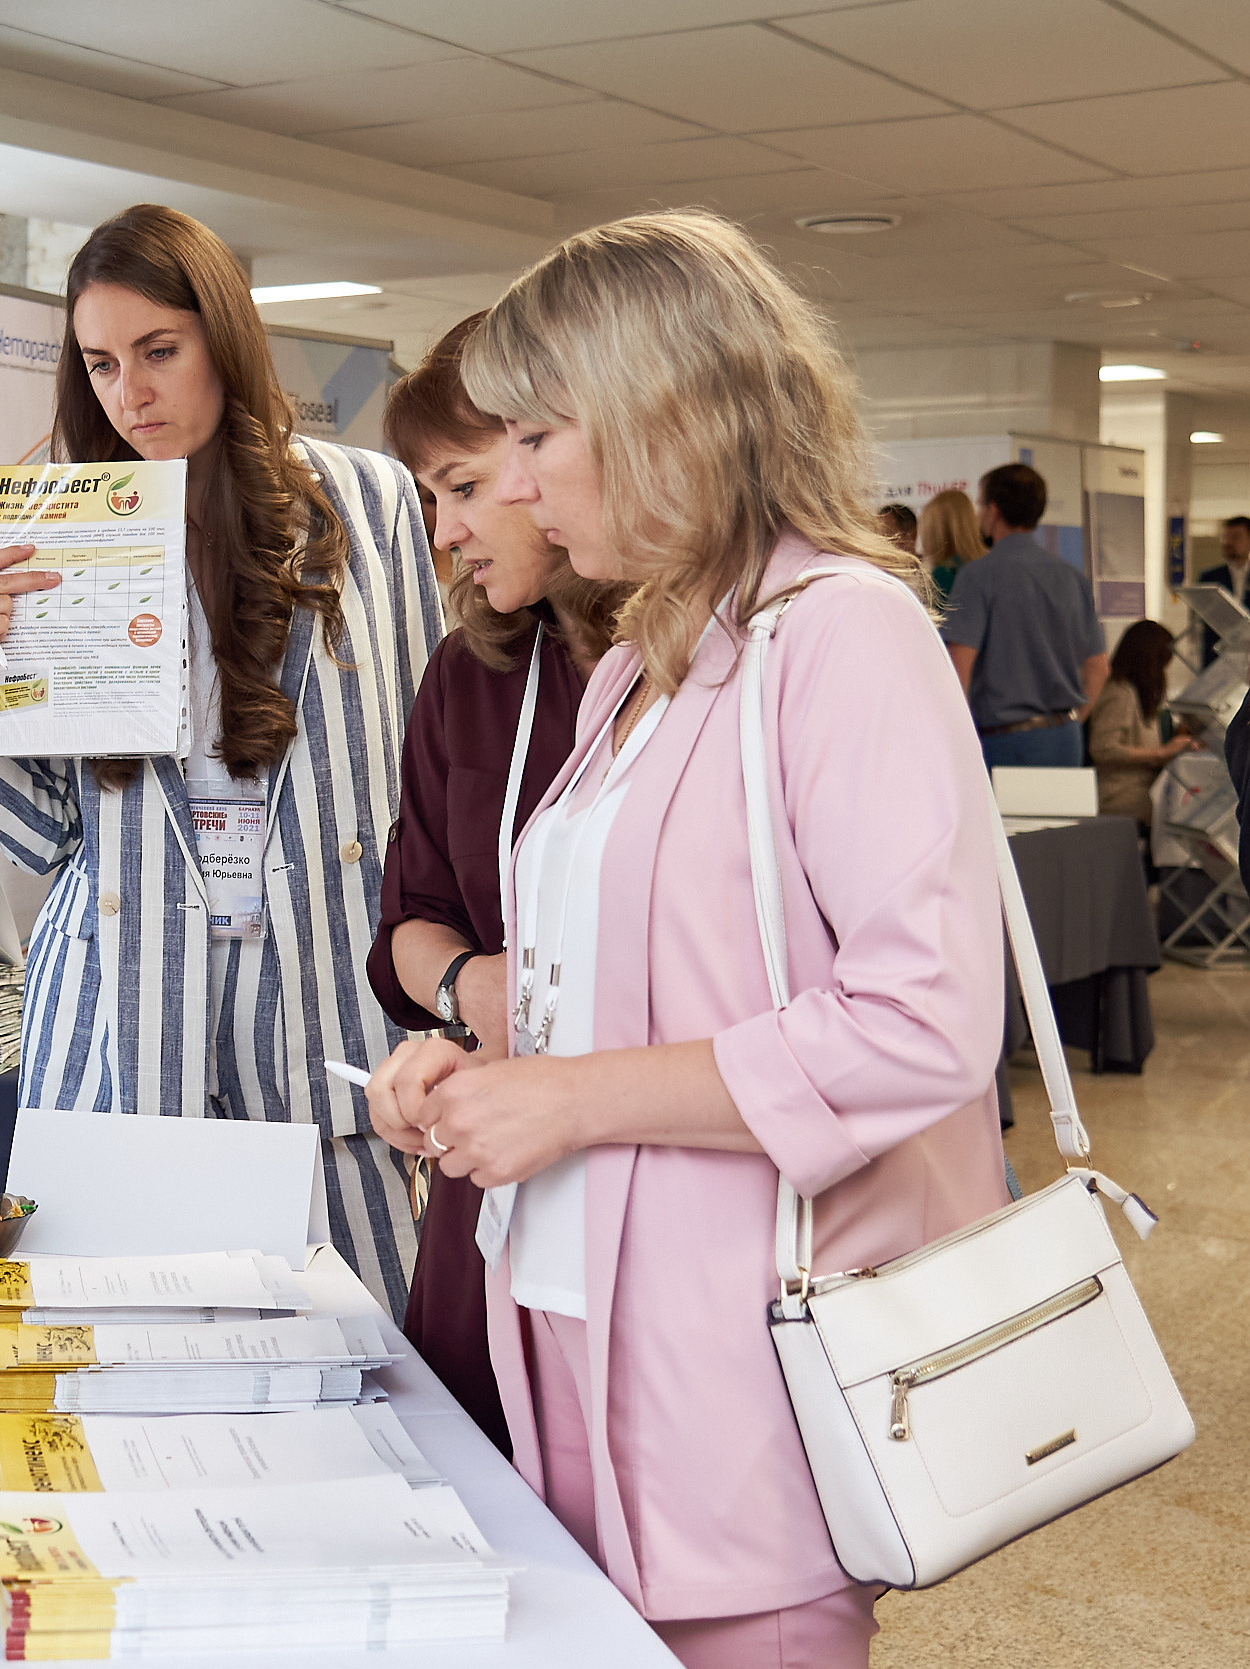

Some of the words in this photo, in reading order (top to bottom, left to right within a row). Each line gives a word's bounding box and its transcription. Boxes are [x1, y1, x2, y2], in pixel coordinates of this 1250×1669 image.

[40, 511, 67, 520] камней
[194, 818, 226, 831] ТРЕЧИ
[212, 869, 253, 881] Юрьевна
